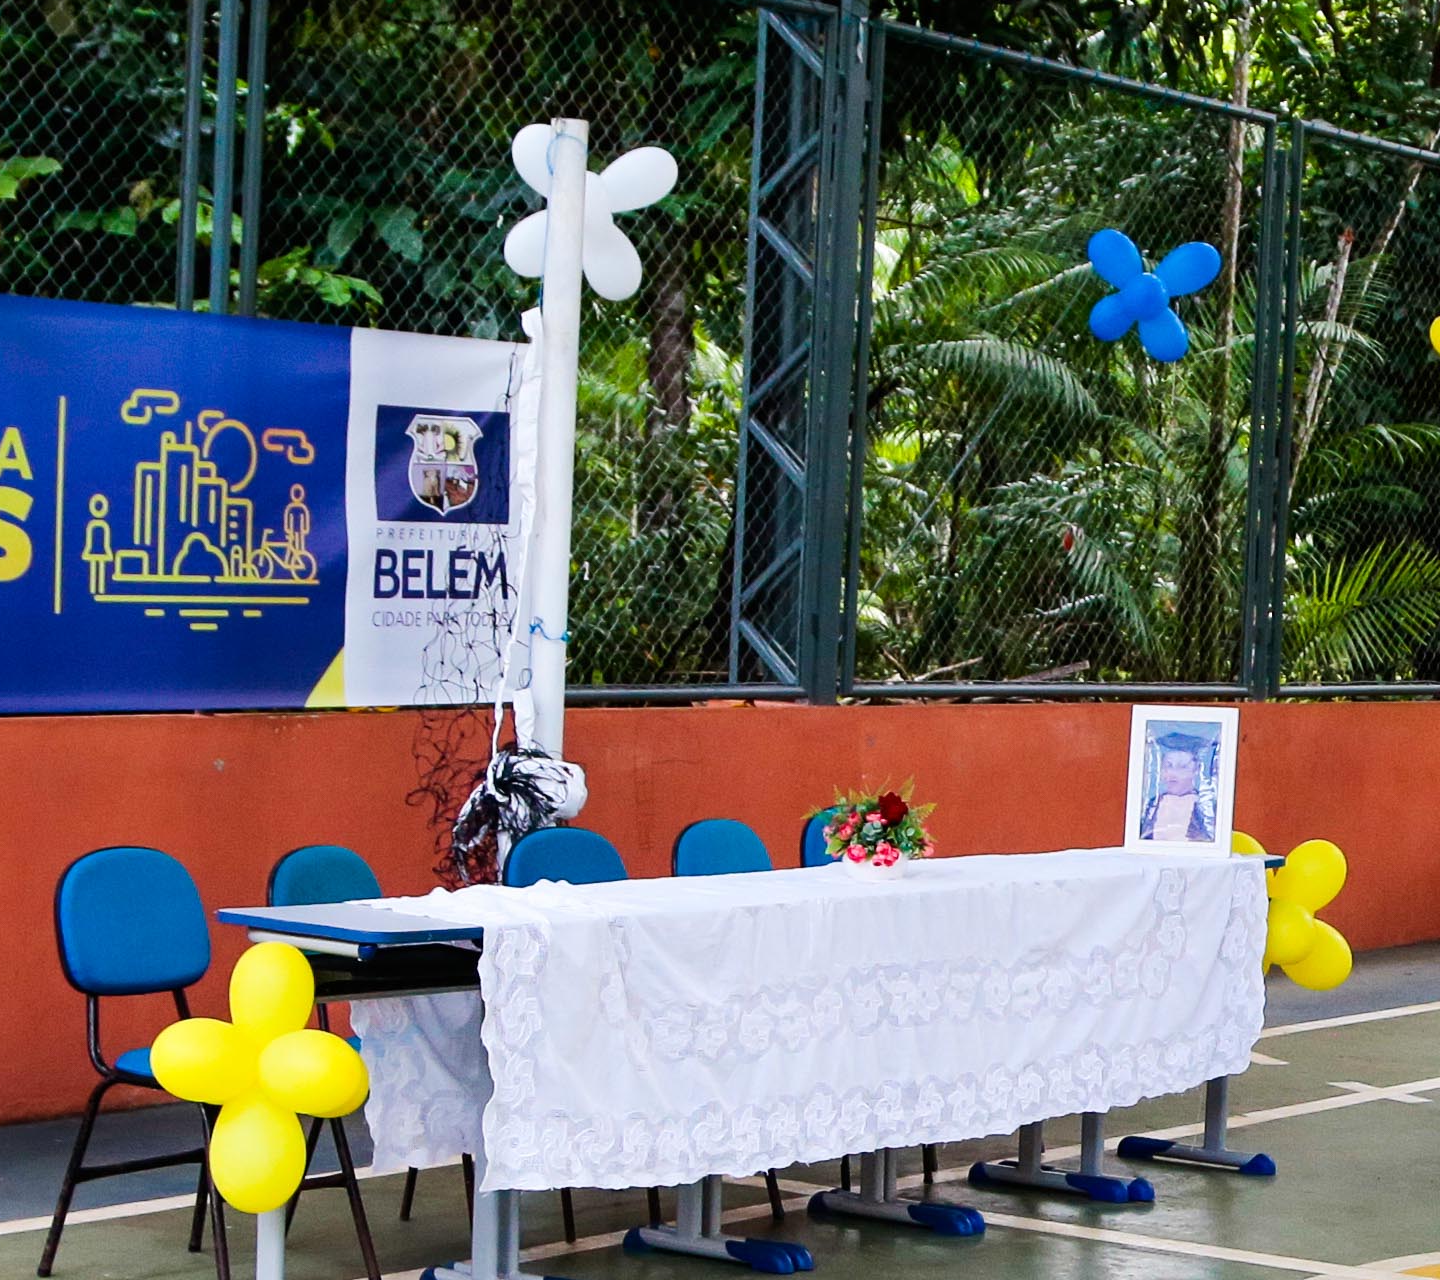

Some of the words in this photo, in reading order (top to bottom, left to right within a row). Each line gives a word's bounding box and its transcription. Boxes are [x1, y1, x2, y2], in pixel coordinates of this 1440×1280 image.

[375, 527, 480, 543] PREFEITURA
[372, 544, 509, 600] BELÉM
[371, 610, 422, 628] CIDADE
[426, 610, 460, 628] PARA
[463, 610, 509, 628] TODOS
